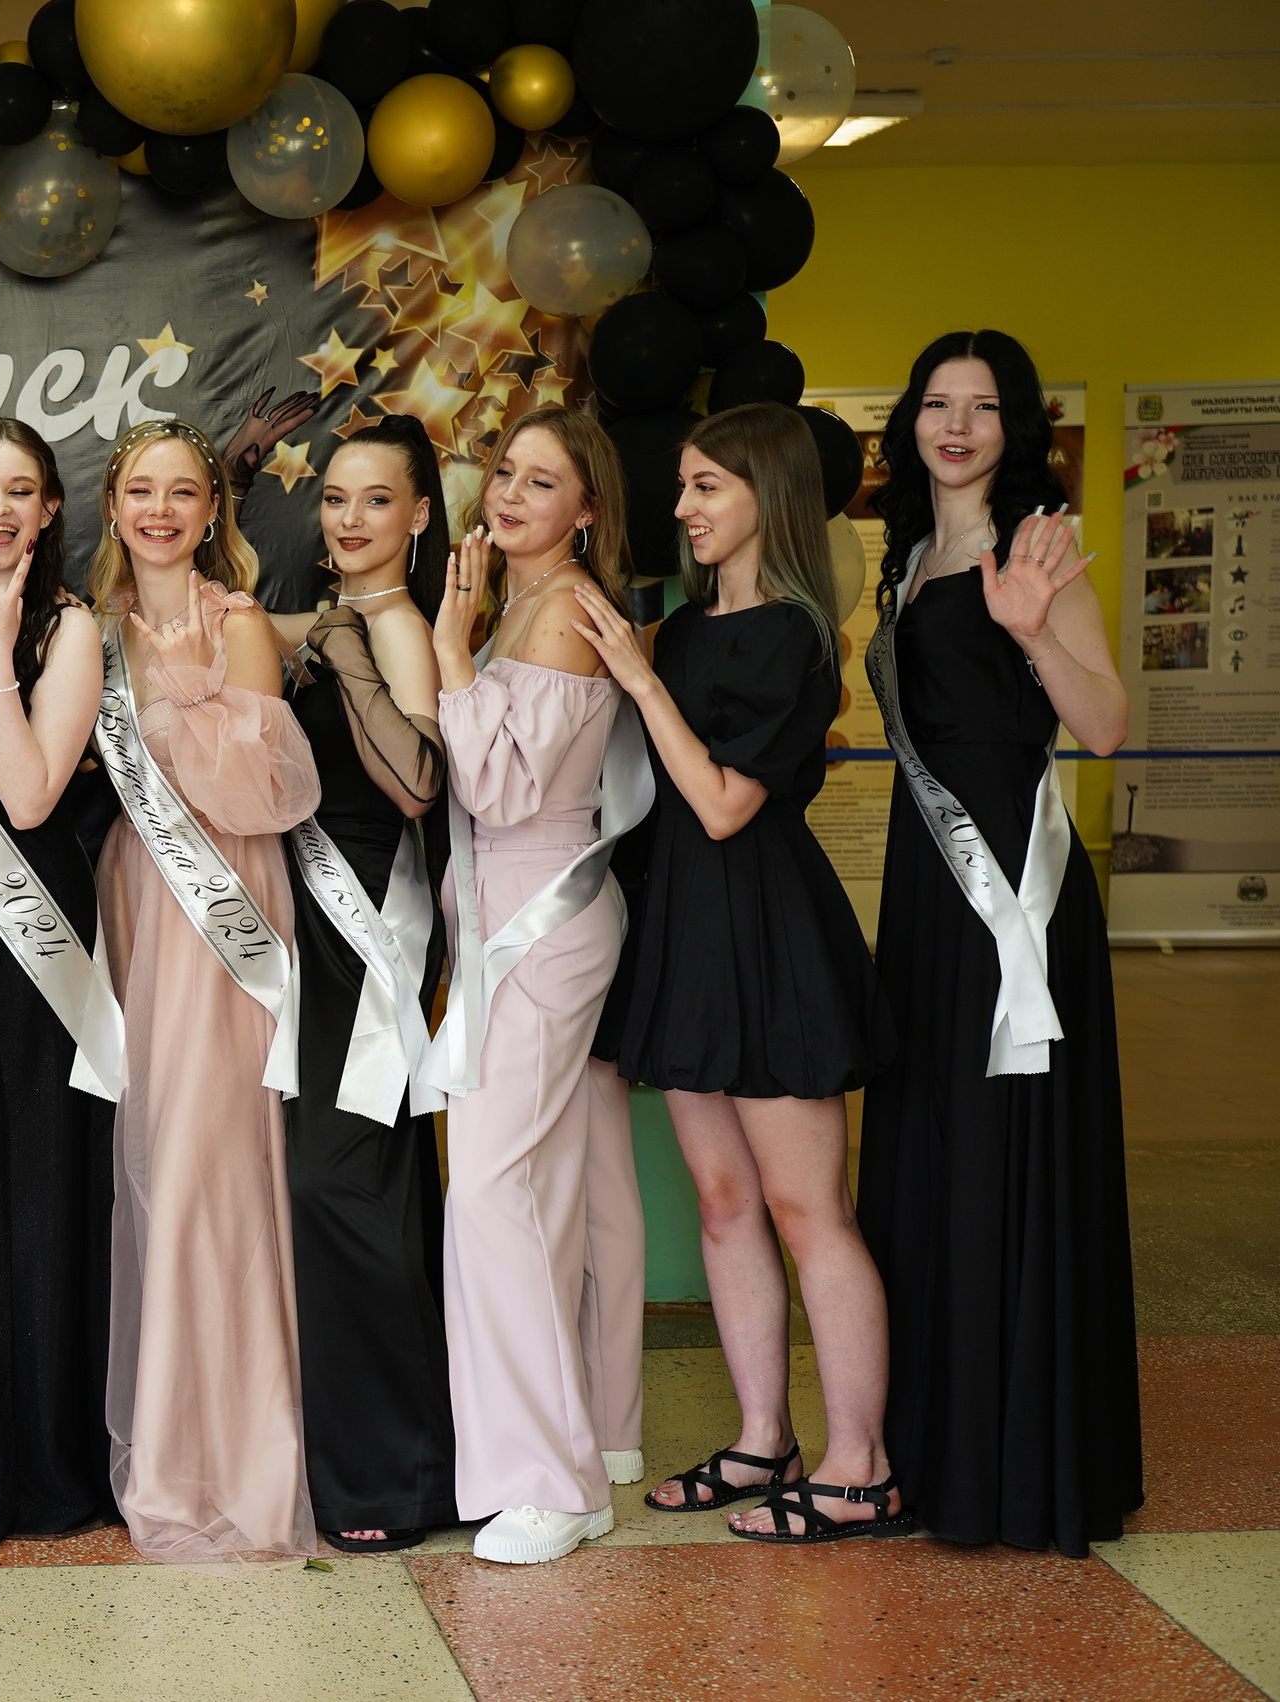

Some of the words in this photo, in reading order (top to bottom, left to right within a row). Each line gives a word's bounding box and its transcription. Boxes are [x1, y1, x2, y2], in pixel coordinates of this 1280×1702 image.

[1254, 404, 1280, 414] МОЛО
[1181, 453, 1204, 467] НЕ
[1209, 450, 1280, 466] МЕРКНЕ
[1181, 464, 1271, 482] ЛЕТОПИСЬ
[97, 687, 198, 874] Выпускница
[186, 874, 272, 961] 2024
